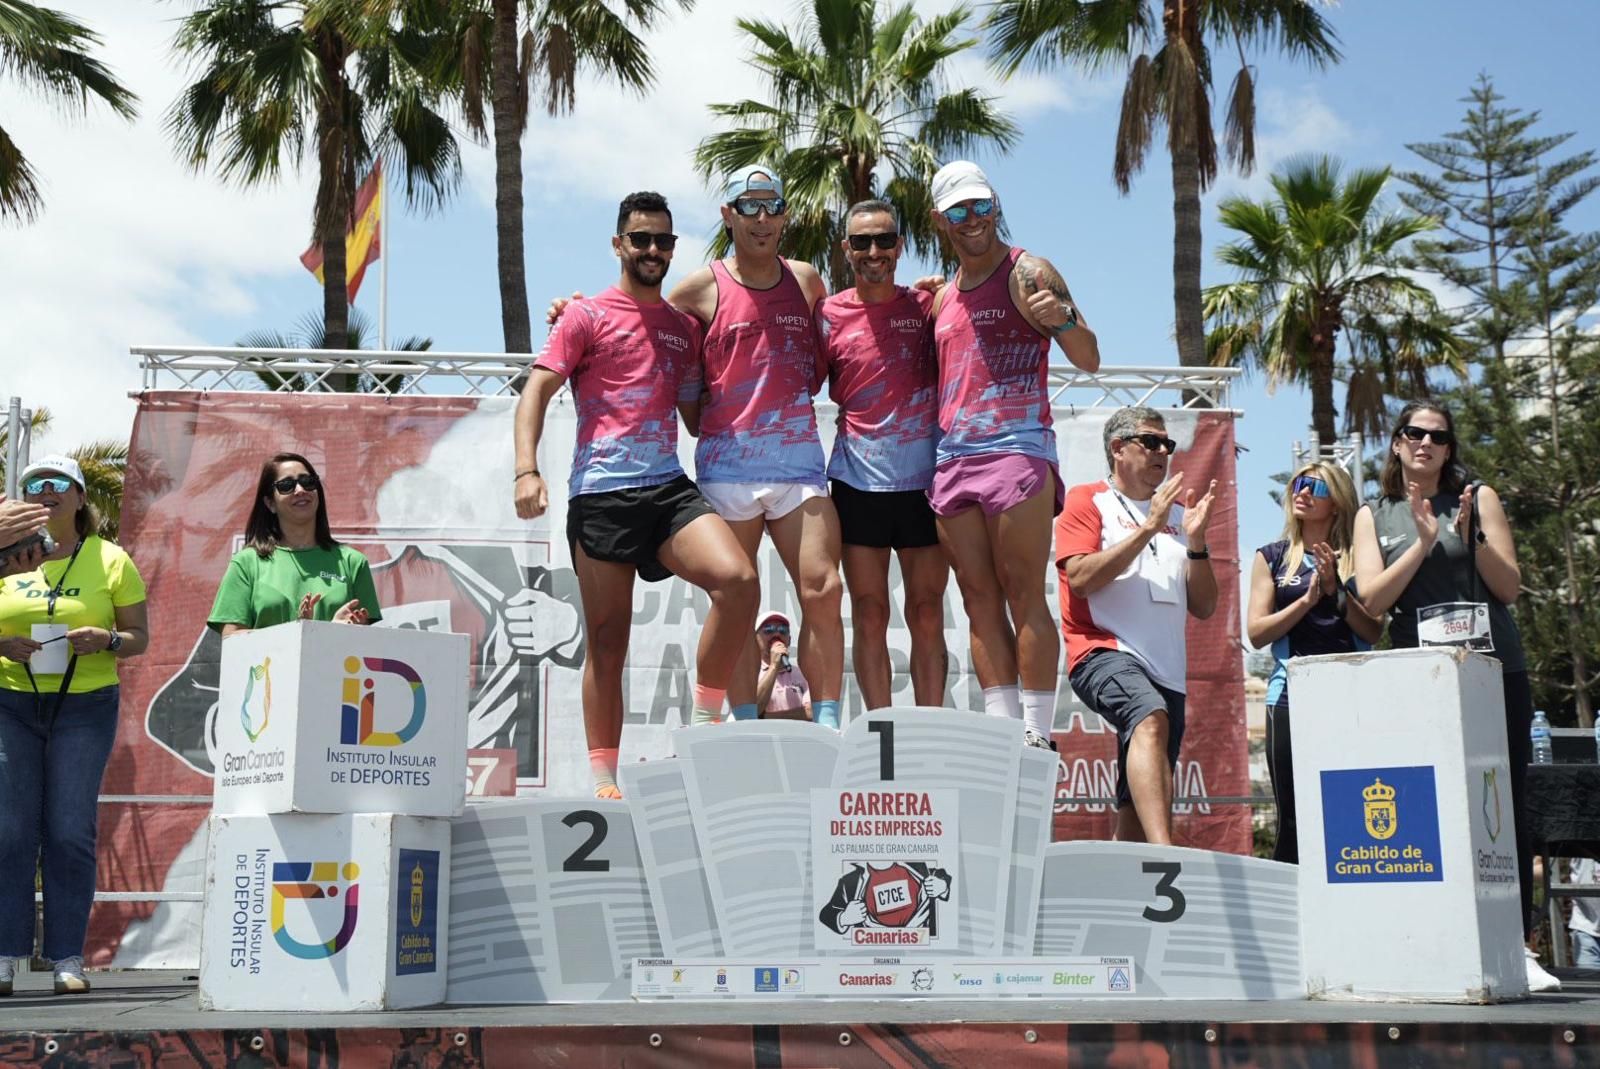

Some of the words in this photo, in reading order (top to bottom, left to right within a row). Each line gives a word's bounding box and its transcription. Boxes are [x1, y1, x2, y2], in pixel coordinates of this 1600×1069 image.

[326, 747, 385, 765] INSTITUTO
[389, 750, 437, 768] INSULAR
[868, 720, 894, 781] 1
[331, 771, 346, 784] DE
[350, 768, 430, 787] DEPORTES
[839, 792, 933, 816] CARRERA
[830, 820, 847, 836] DE
[849, 820, 872, 836] LAS
[874, 820, 942, 836] EMPRESAS
[561, 810, 610, 872] 2
[831, 844, 844, 854] LAS
[845, 844, 875, 854] PALMAS
[876, 844, 885, 854] DE
[886, 844, 906, 854] GRAN
[907, 844, 939, 854] CANARIA
[236, 854, 247, 871] DE
[1341, 845, 1399, 860] Cabildo
[1402, 844, 1422, 859] de
[1335, 861, 1371, 875] Gran
[1375, 860, 1434, 874] Canaria
[252, 849, 270, 914] INSTITUTO
[877, 886, 906, 907] C7CE
[1142, 862, 1186, 923] 3
[230, 876, 250, 968] DEPORTES
[249, 919, 266, 975] INSULAR
[1006, 973, 1043, 984] cajamar
[1052, 972, 1096, 985] Binter
